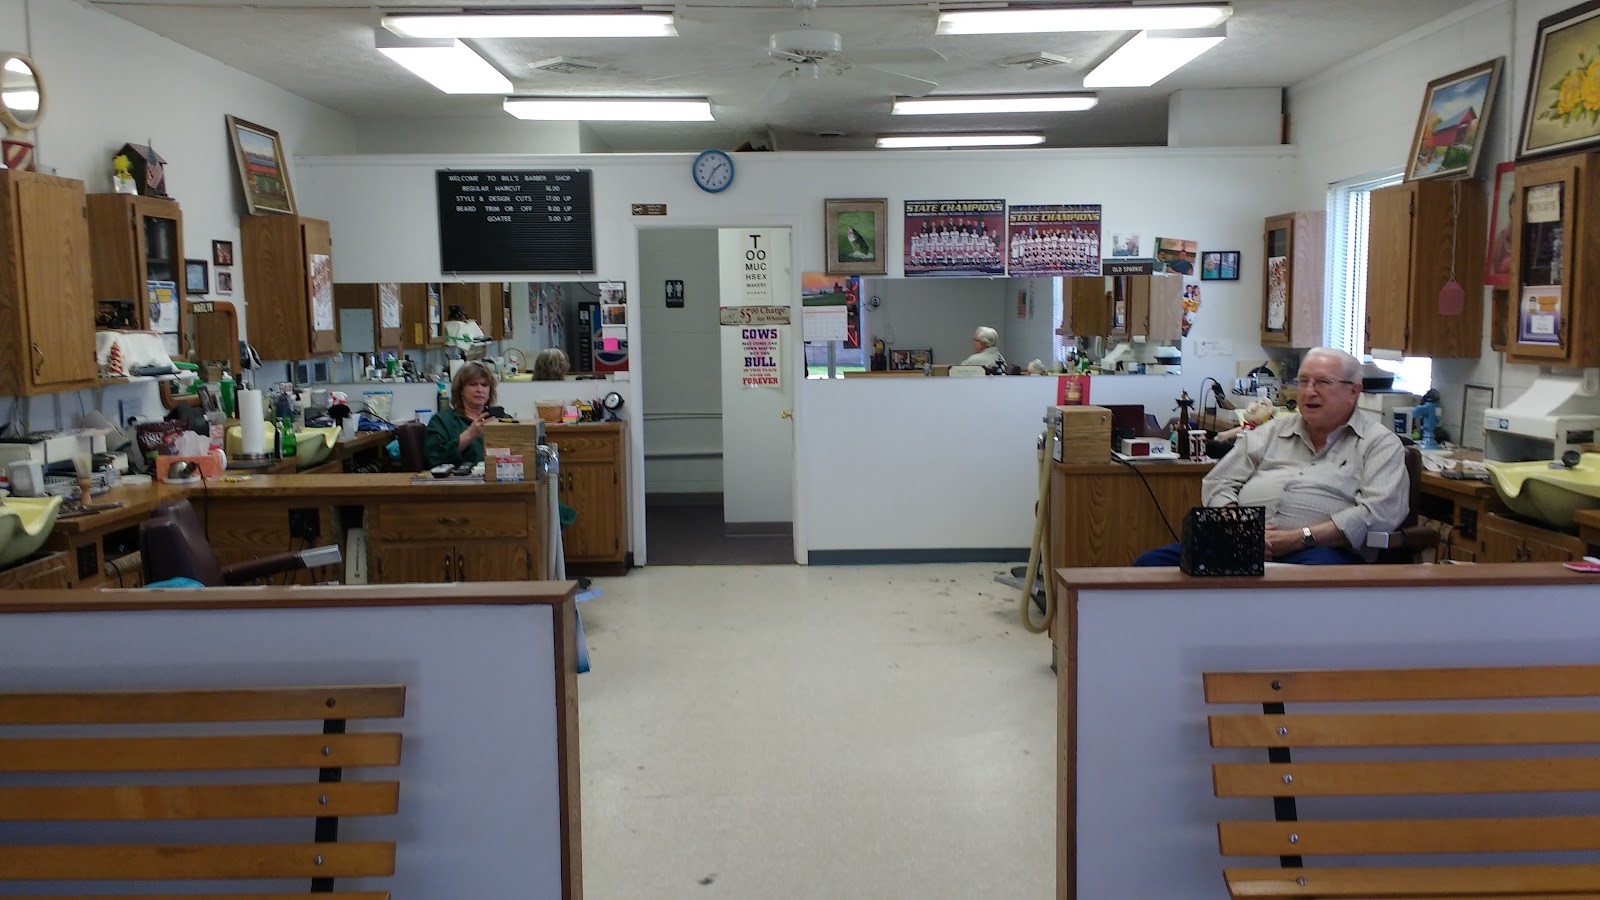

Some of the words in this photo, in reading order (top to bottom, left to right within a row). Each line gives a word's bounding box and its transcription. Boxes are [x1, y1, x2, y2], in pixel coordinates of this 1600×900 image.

[906, 204, 938, 212] STATE
[940, 203, 1003, 211] CHAMPIONS
[1009, 214, 1040, 222] STATE
[1041, 213, 1100, 221] CHAMPIONS
[749, 234, 761, 249] T
[745, 249, 766, 261] OO
[745, 262, 767, 271] MUC
[760, 306, 786, 316] Charge
[742, 328, 778, 340] COWS
[744, 356, 776, 367] BULL
[742, 377, 778, 385] FOREVER
